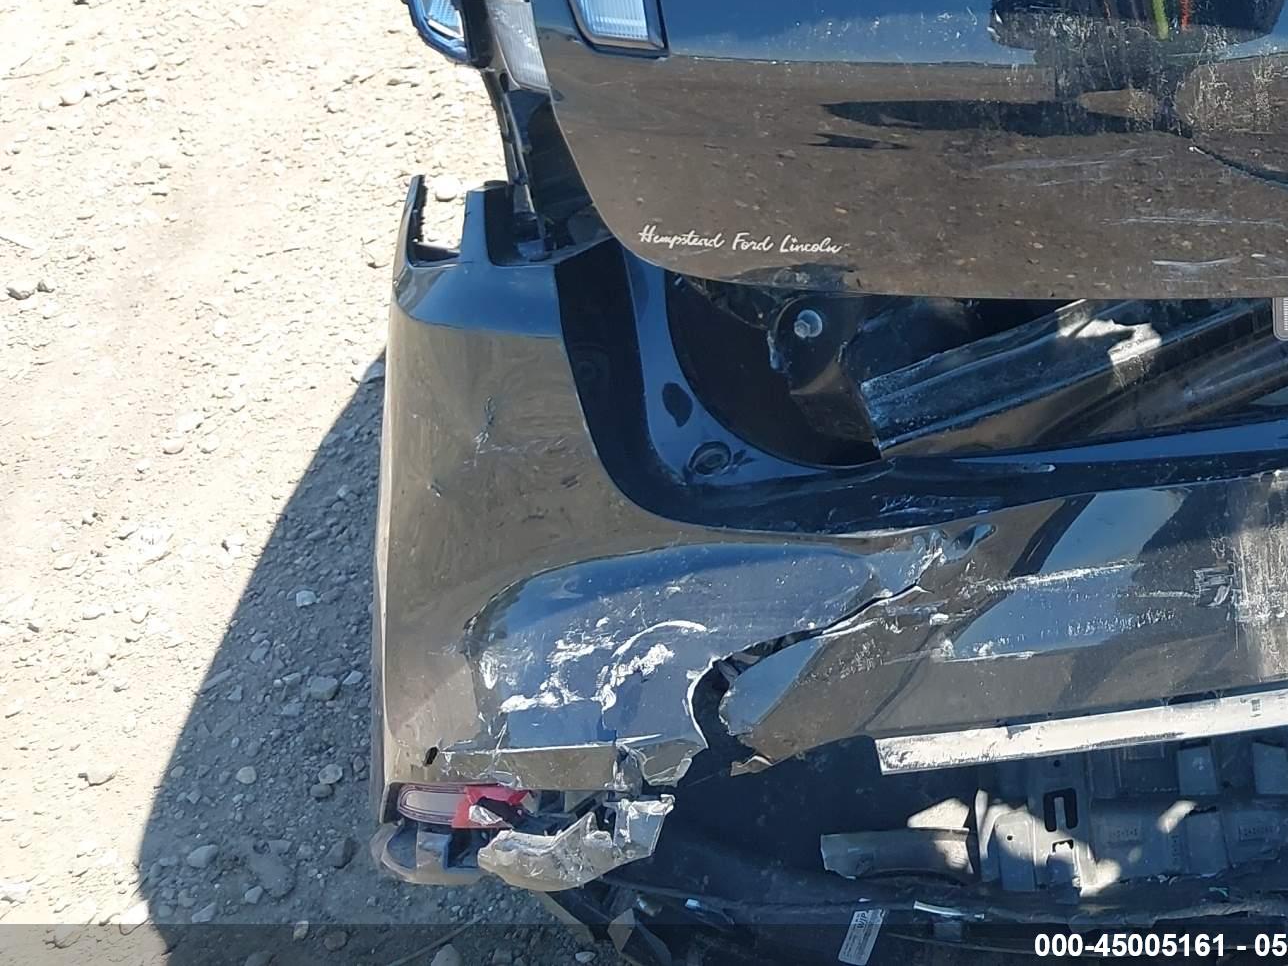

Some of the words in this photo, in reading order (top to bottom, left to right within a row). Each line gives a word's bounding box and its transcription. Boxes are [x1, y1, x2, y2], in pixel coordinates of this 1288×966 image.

[638, 224, 725, 249] Hempstead
[732, 232, 774, 251] Ford
[780, 234, 842, 254] Lincoln
